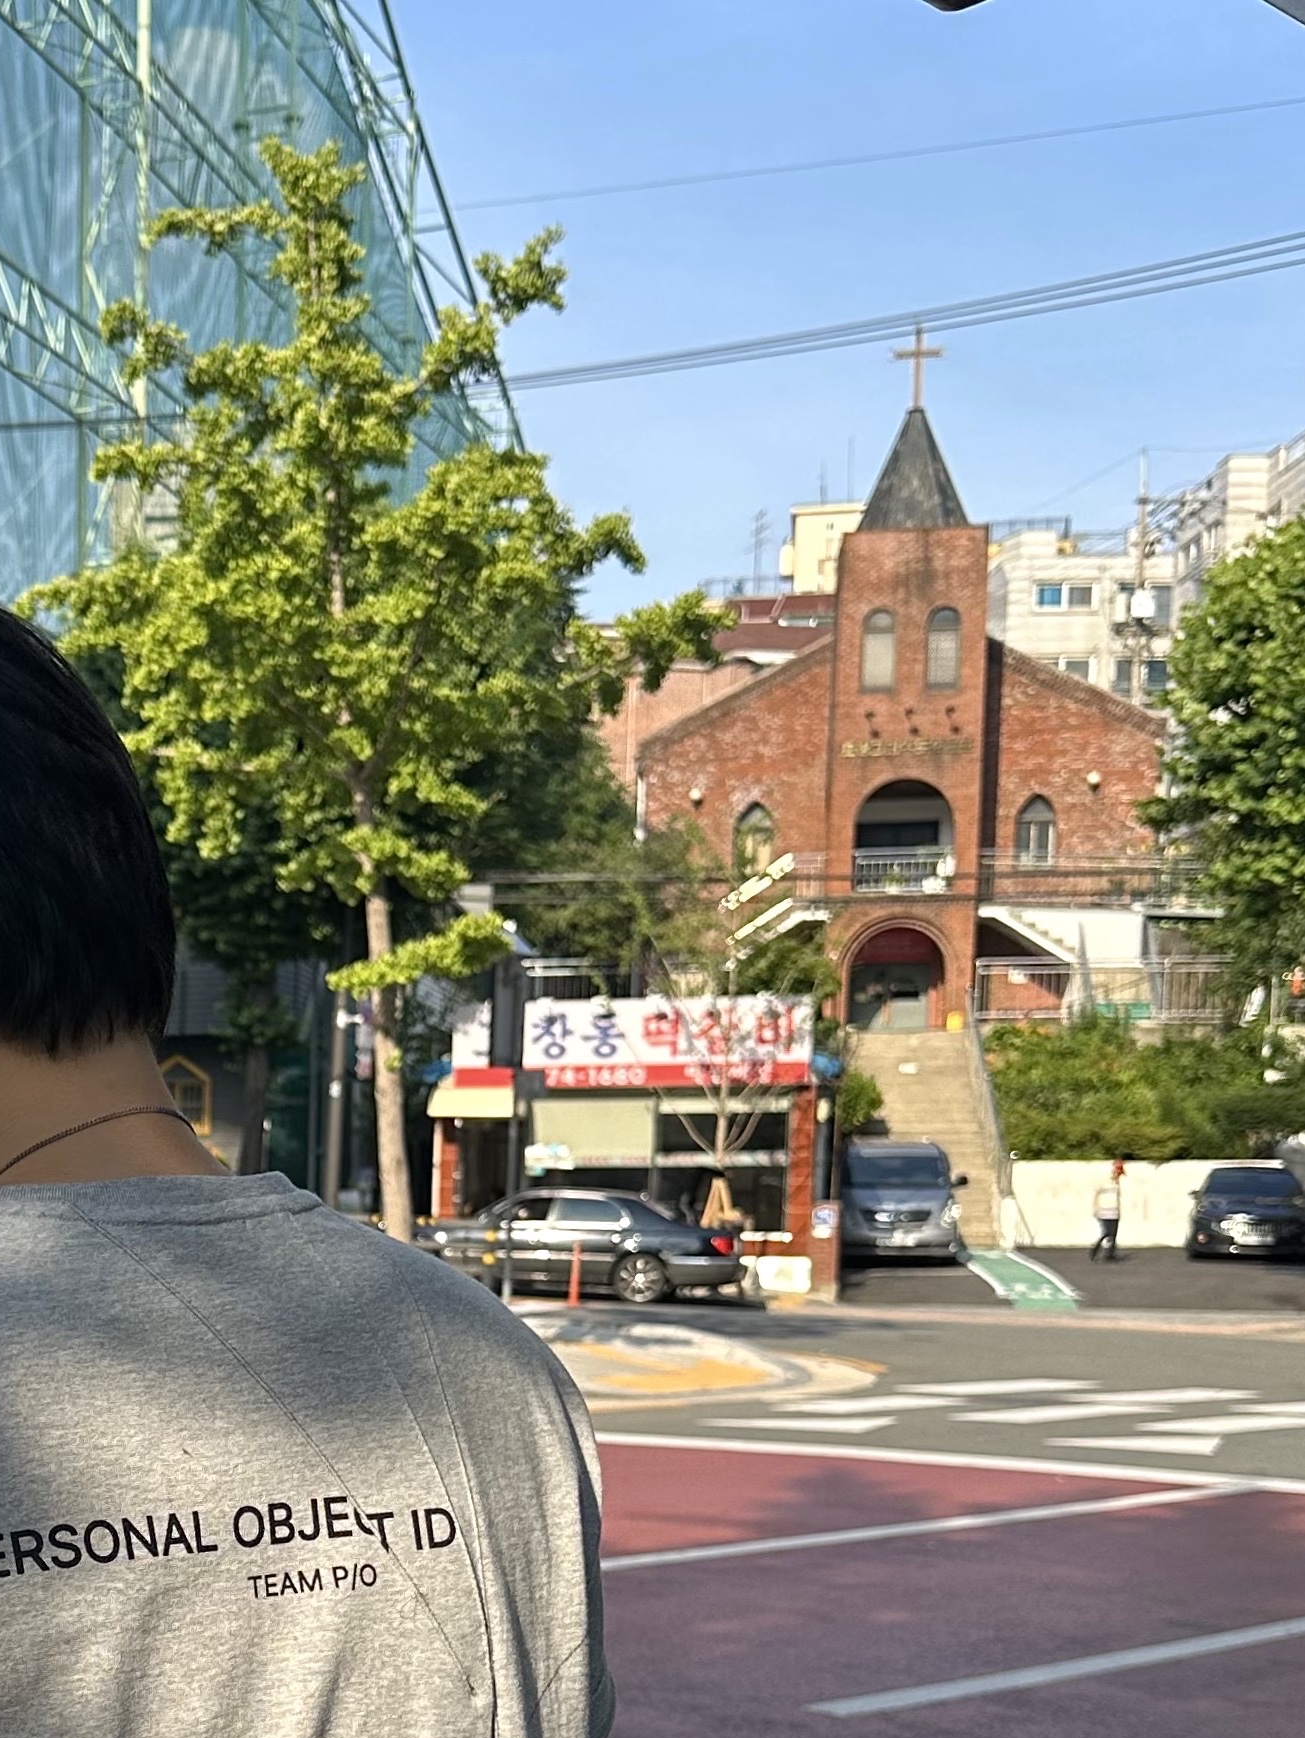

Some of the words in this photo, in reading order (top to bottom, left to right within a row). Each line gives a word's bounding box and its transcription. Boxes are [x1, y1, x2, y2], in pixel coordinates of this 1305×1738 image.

[411, 1507, 457, 1551] ID
[248, 1568, 323, 1599] TEAM
[332, 1563, 378, 1590] P/O
